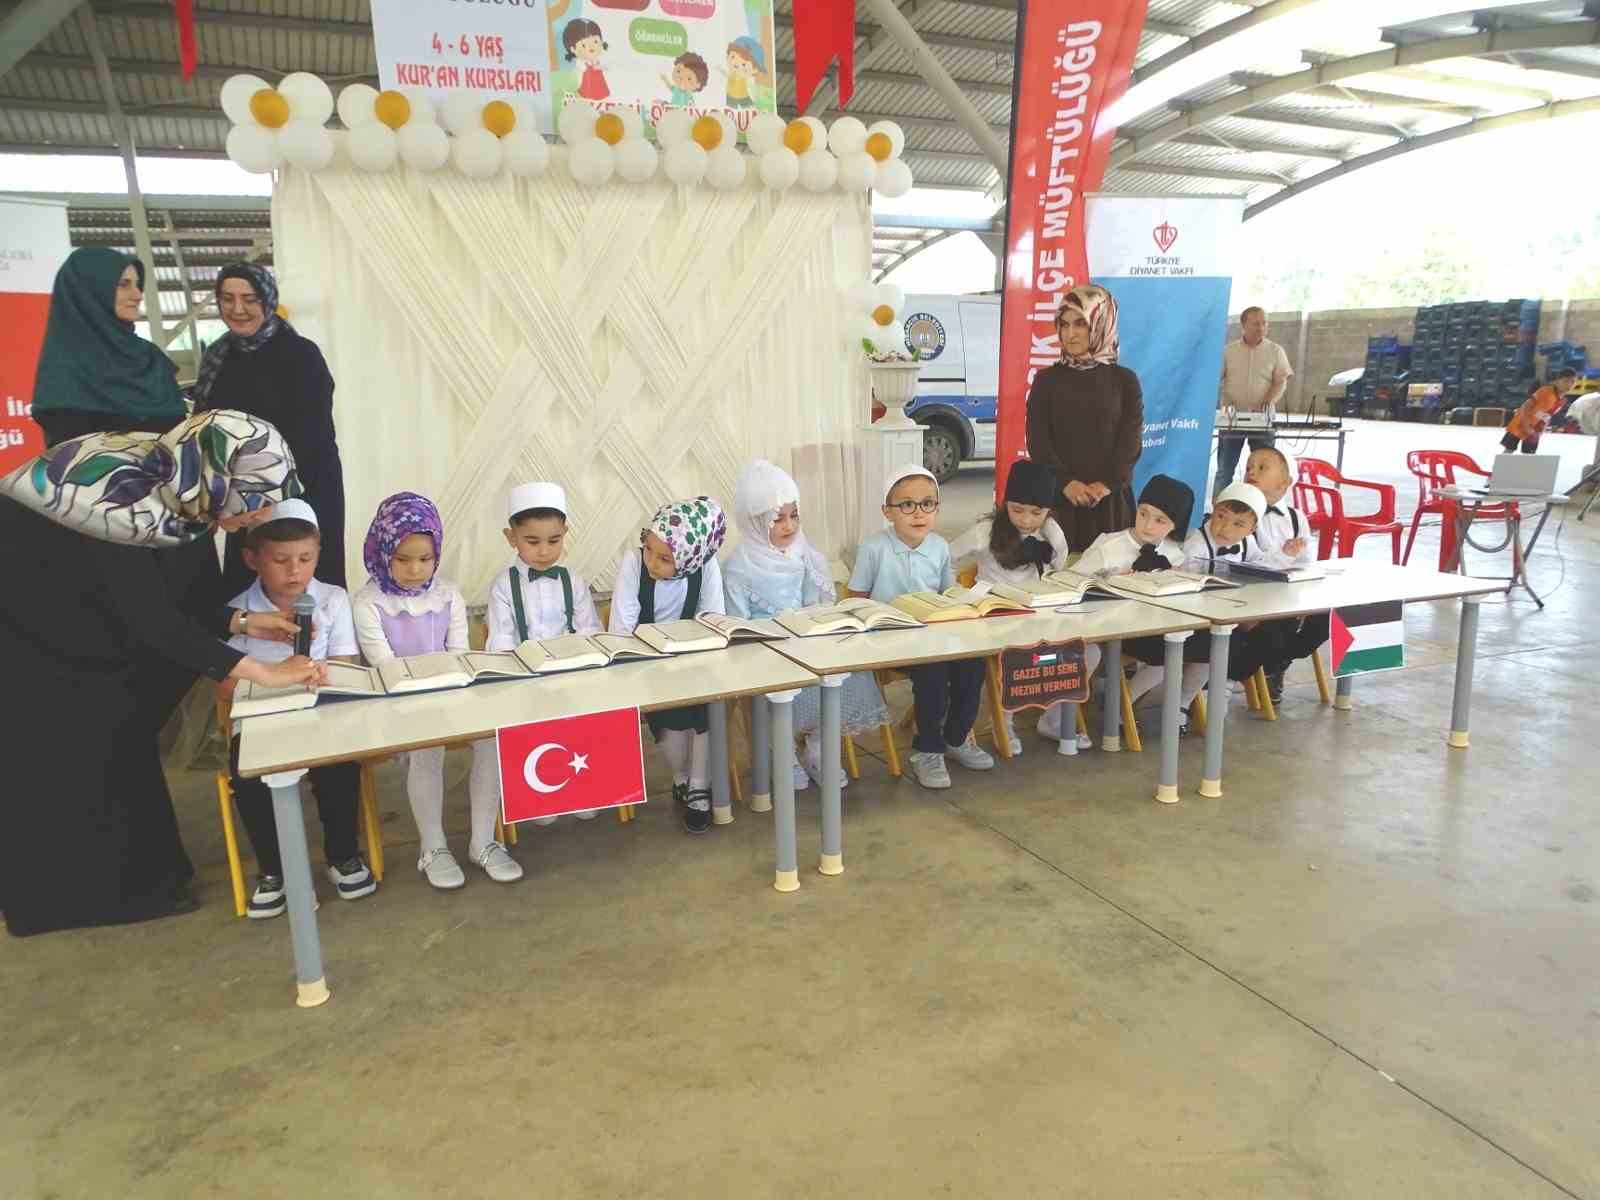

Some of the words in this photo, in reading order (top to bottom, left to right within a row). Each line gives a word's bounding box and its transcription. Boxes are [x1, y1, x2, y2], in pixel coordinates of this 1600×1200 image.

[432, 32, 442, 54] 4
[460, 34, 470, 55] 6
[475, 35, 504, 64] YAŞ
[396, 63, 460, 88] KUR'AN
[465, 67, 543, 93] KURSLARI
[1039, 20, 1101, 239] MÜFTÜLÜĞÜ
[1013, 668, 1041, 680] GAZZE
[1043, 665, 1055, 677] BU
